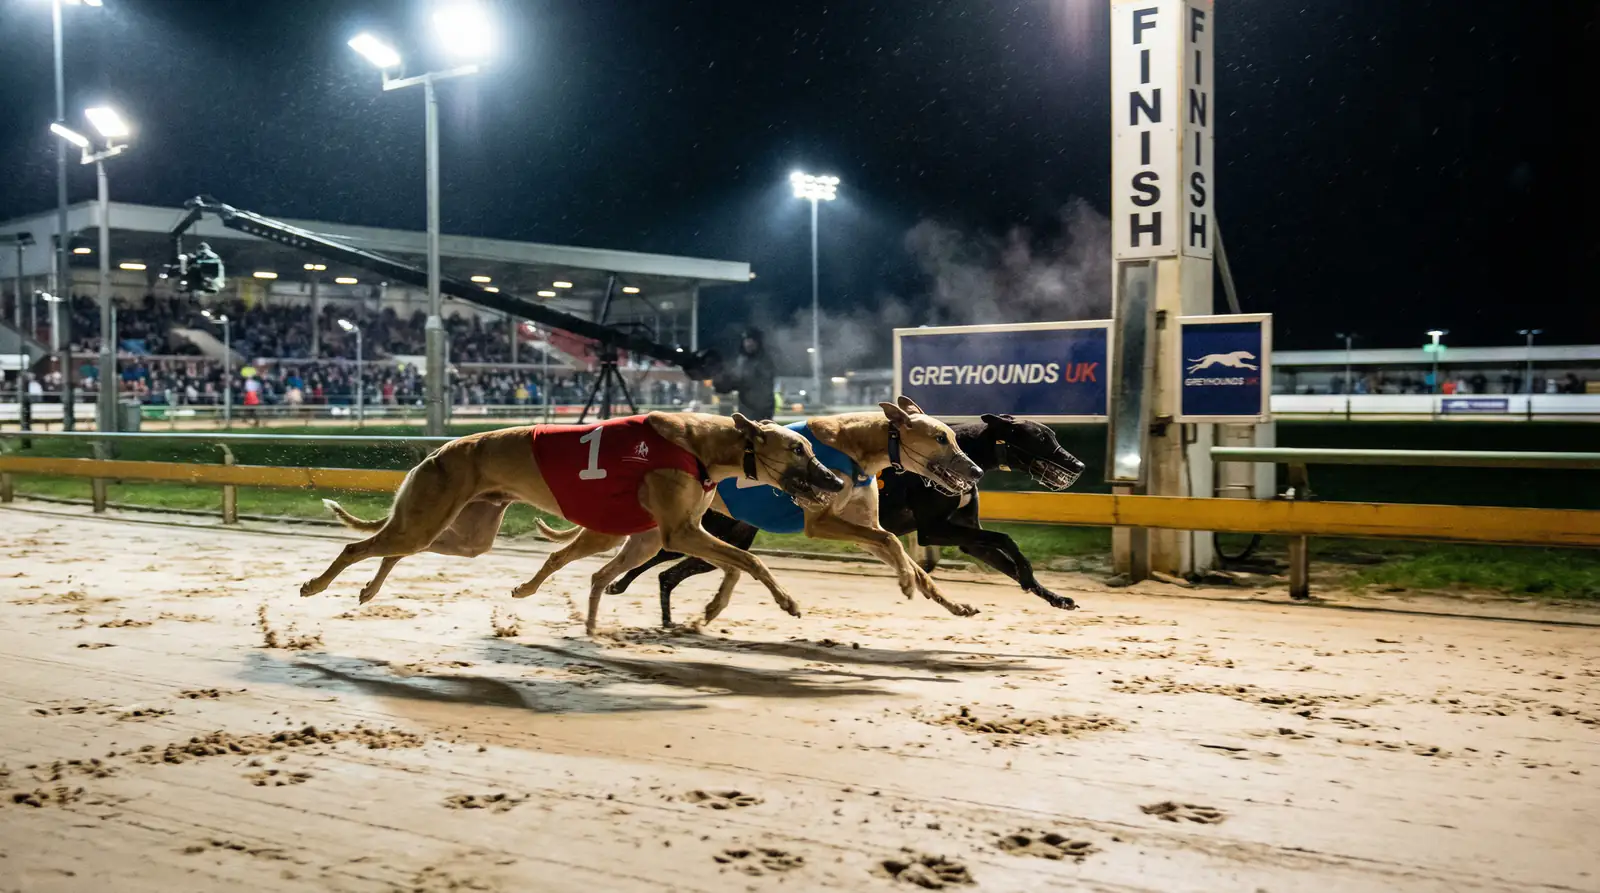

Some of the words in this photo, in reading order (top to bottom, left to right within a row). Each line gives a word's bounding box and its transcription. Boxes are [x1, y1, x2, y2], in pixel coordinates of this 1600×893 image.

[1129, 6, 1162, 248] FINISH
[1189, 7, 1206, 249] FINISH
[909, 363, 1060, 386] GREYHOUNDS
[1065, 362, 1099, 383] UK
[1184, 377, 1245, 386] GREYHOUNDS
[578, 425, 607, 480] 1
